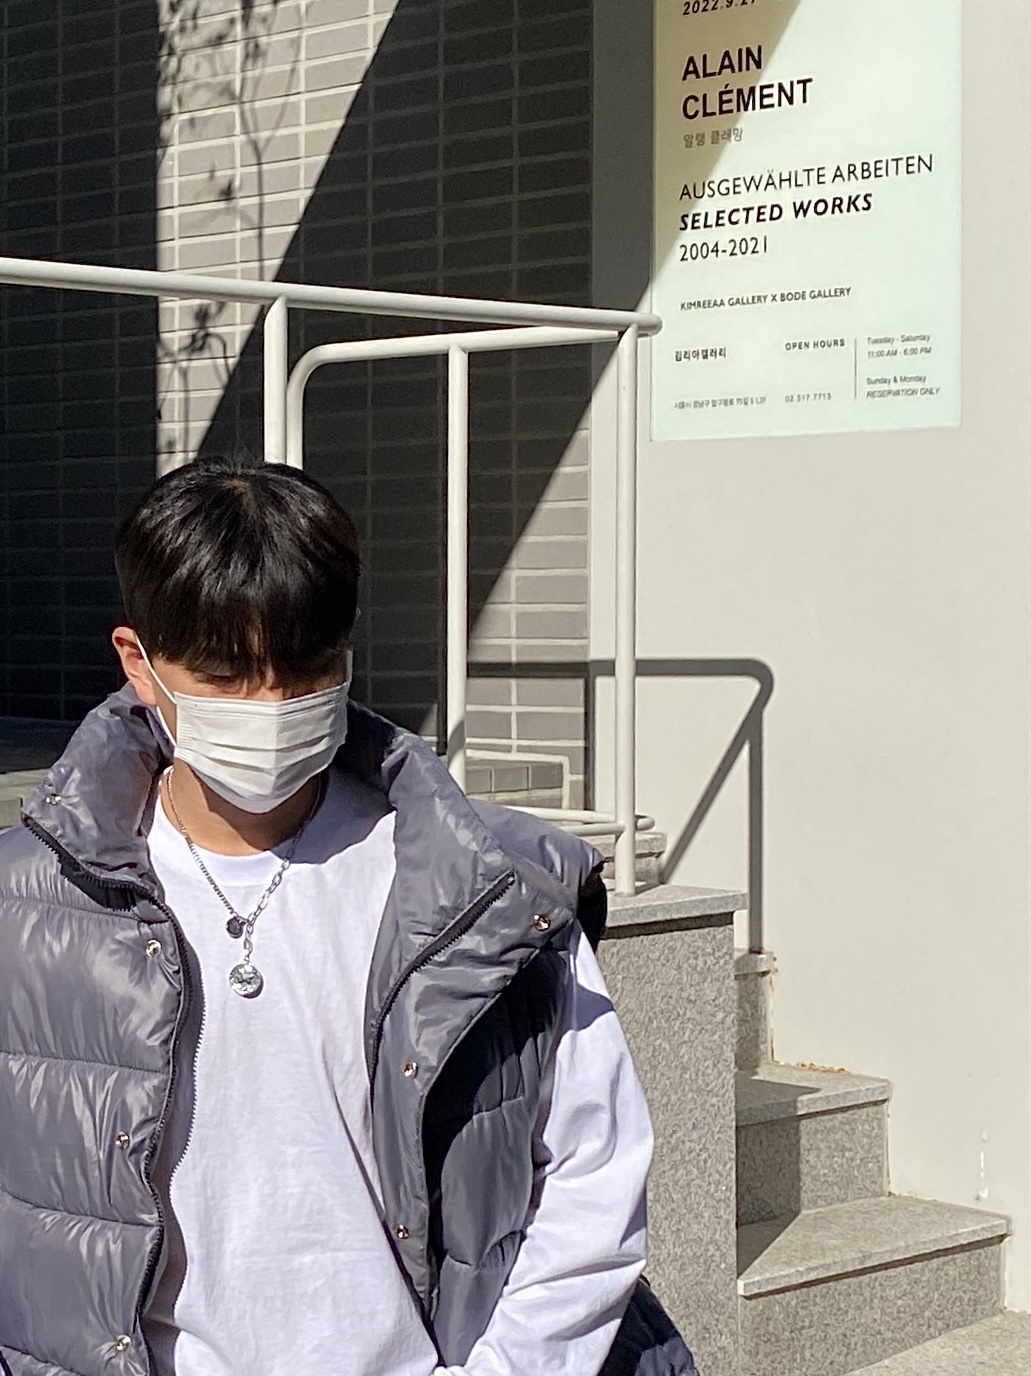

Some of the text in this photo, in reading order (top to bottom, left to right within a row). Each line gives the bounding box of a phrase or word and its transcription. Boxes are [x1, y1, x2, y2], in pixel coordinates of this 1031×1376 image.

[682, 0, 756, 15] 2022.9.
[681, 45, 763, 81] ALAIN
[681, 78, 814, 120] CLÉMENT
[679, 153, 933, 201] AUSGEWÄHLTE ARBEITEN
[679, 192, 873, 231] SELECTED WORKS
[679, 235, 768, 262] 2004-2021
[680, 286, 852, 311] KIMREEAA GALLERY X BODE GALLERY
[785, 338, 846, 351] OPEN HOURS
